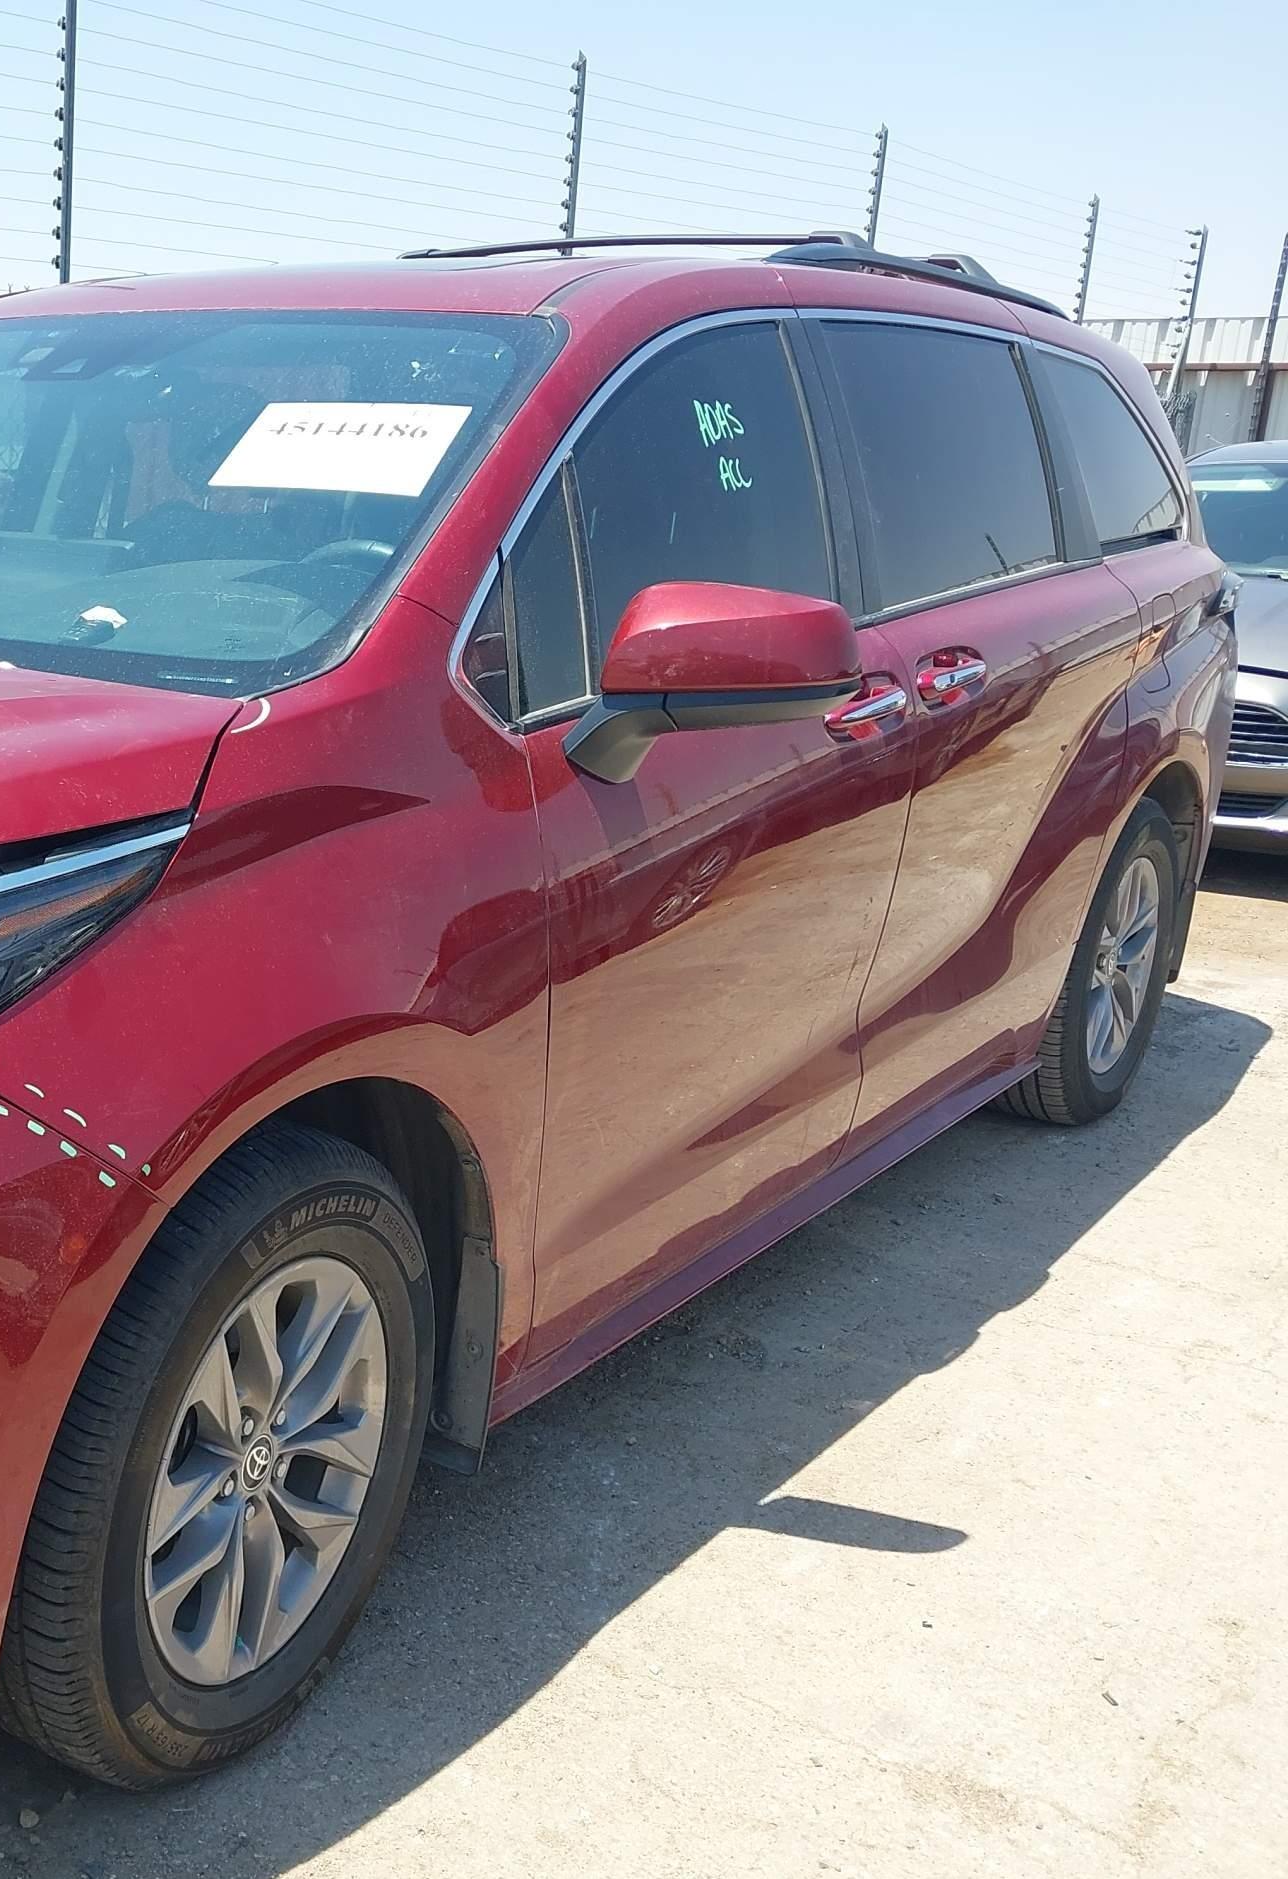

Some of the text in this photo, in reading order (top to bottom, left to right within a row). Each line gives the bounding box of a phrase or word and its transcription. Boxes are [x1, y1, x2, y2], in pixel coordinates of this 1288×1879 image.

[268, 420, 429, 440] 45144186
[693, 399, 745, 447] ADAS
[290, 1195, 417, 1264] MICHELIN DEFENDER
